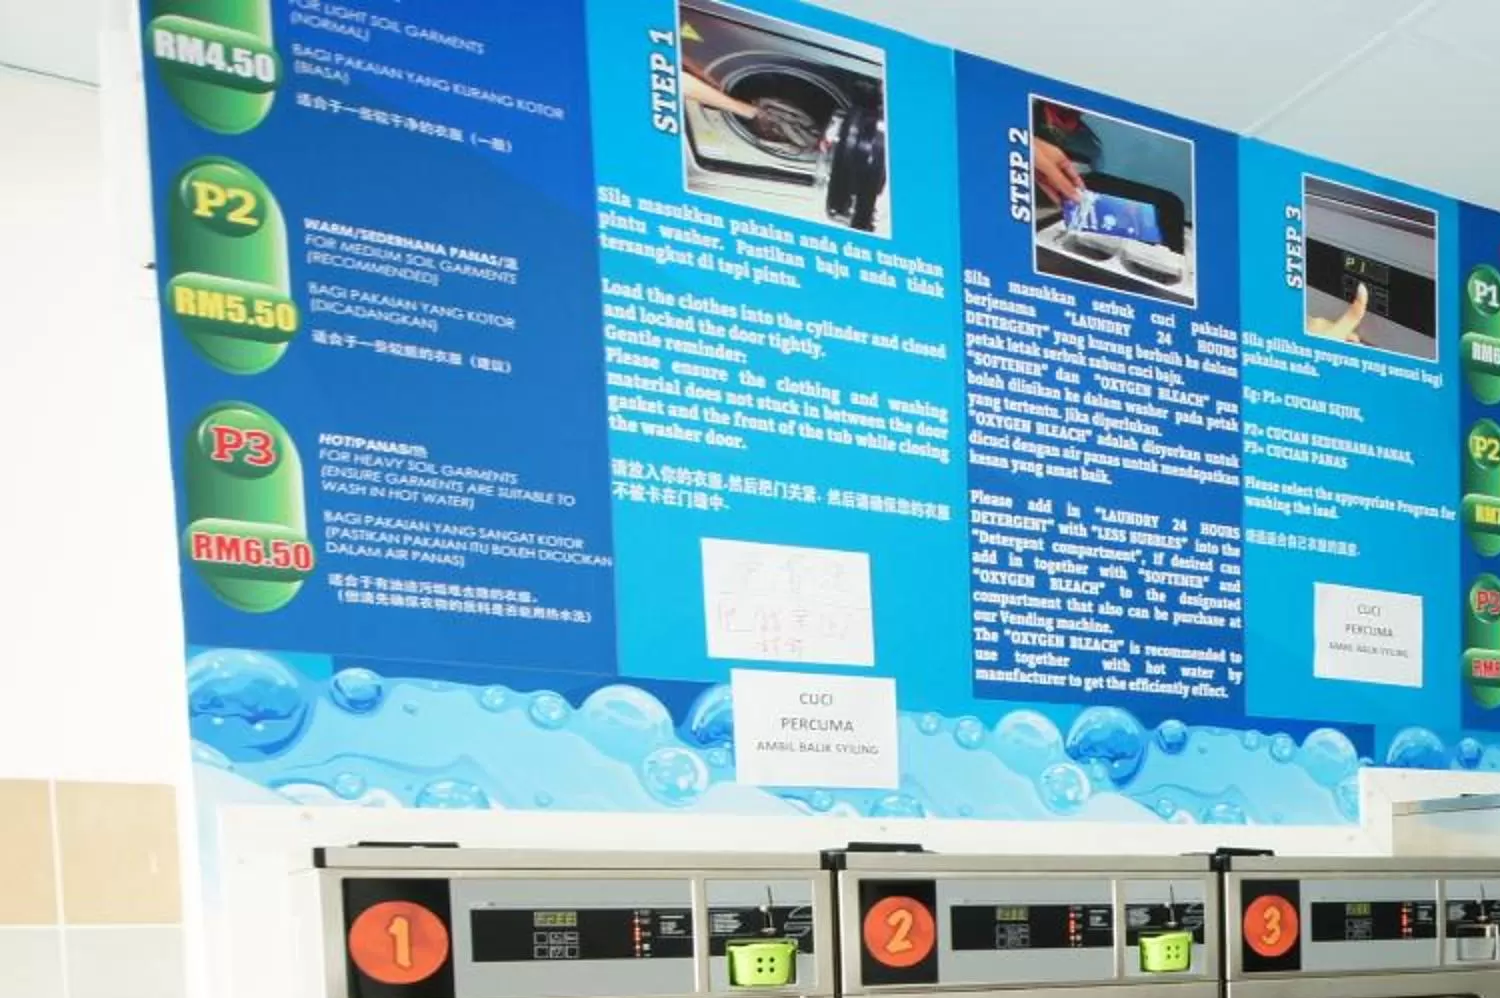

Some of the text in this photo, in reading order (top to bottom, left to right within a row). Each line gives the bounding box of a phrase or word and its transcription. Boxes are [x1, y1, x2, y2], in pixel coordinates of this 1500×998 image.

[153, 28, 276, 82] RM4.50
[649, 30, 678, 134] STEP 1
[1009, 127, 1031, 223] STEP 2
[192, 180, 259, 227] P2
[598, 186, 943, 278] Sila masukkan pakaian anda dan tutupkan
[598, 211, 943, 298] pintu washer. Pastikan baju anda tidak
[1286, 206, 1302, 288] STEP 3
[599, 234, 801, 289] tersangkut di tepi pintu.
[174, 286, 297, 332] RM5.50
[602, 278, 946, 359] Load the clothes into the cylinder and closed
[1474, 280, 1500, 307] P1
[603, 302, 825, 358] and locked the door tightly.
[603, 324, 747, 364] Gentle reminder:
[606, 346, 947, 422] Please ensure the clothing and washing
[607, 372, 948, 440] material does not stuck in between the door
[212, 425, 277, 466] P3
[608, 395, 664, 418] gasket
[668, 402, 699, 420] and
[703, 408, 730, 425] the
[734, 411, 776, 433] front
[779, 416, 796, 436] of
[799, 422, 823, 441] the
[856, 429, 896, 451] while
[899, 437, 950, 464] closing
[608, 415, 748, 449] the washer door.
[1472, 435, 1500, 460] P2
[319, 449, 518, 485] FOR HEAVY SOIL GARMENTS
[191, 533, 313, 572] RM6.50
[800, 692, 832, 706] CUCI
[781, 718, 853, 732] PERCUMA
[388, 914, 413, 971] 1
[885, 912, 913, 953] 2
[1260, 909, 1281, 947] 3
